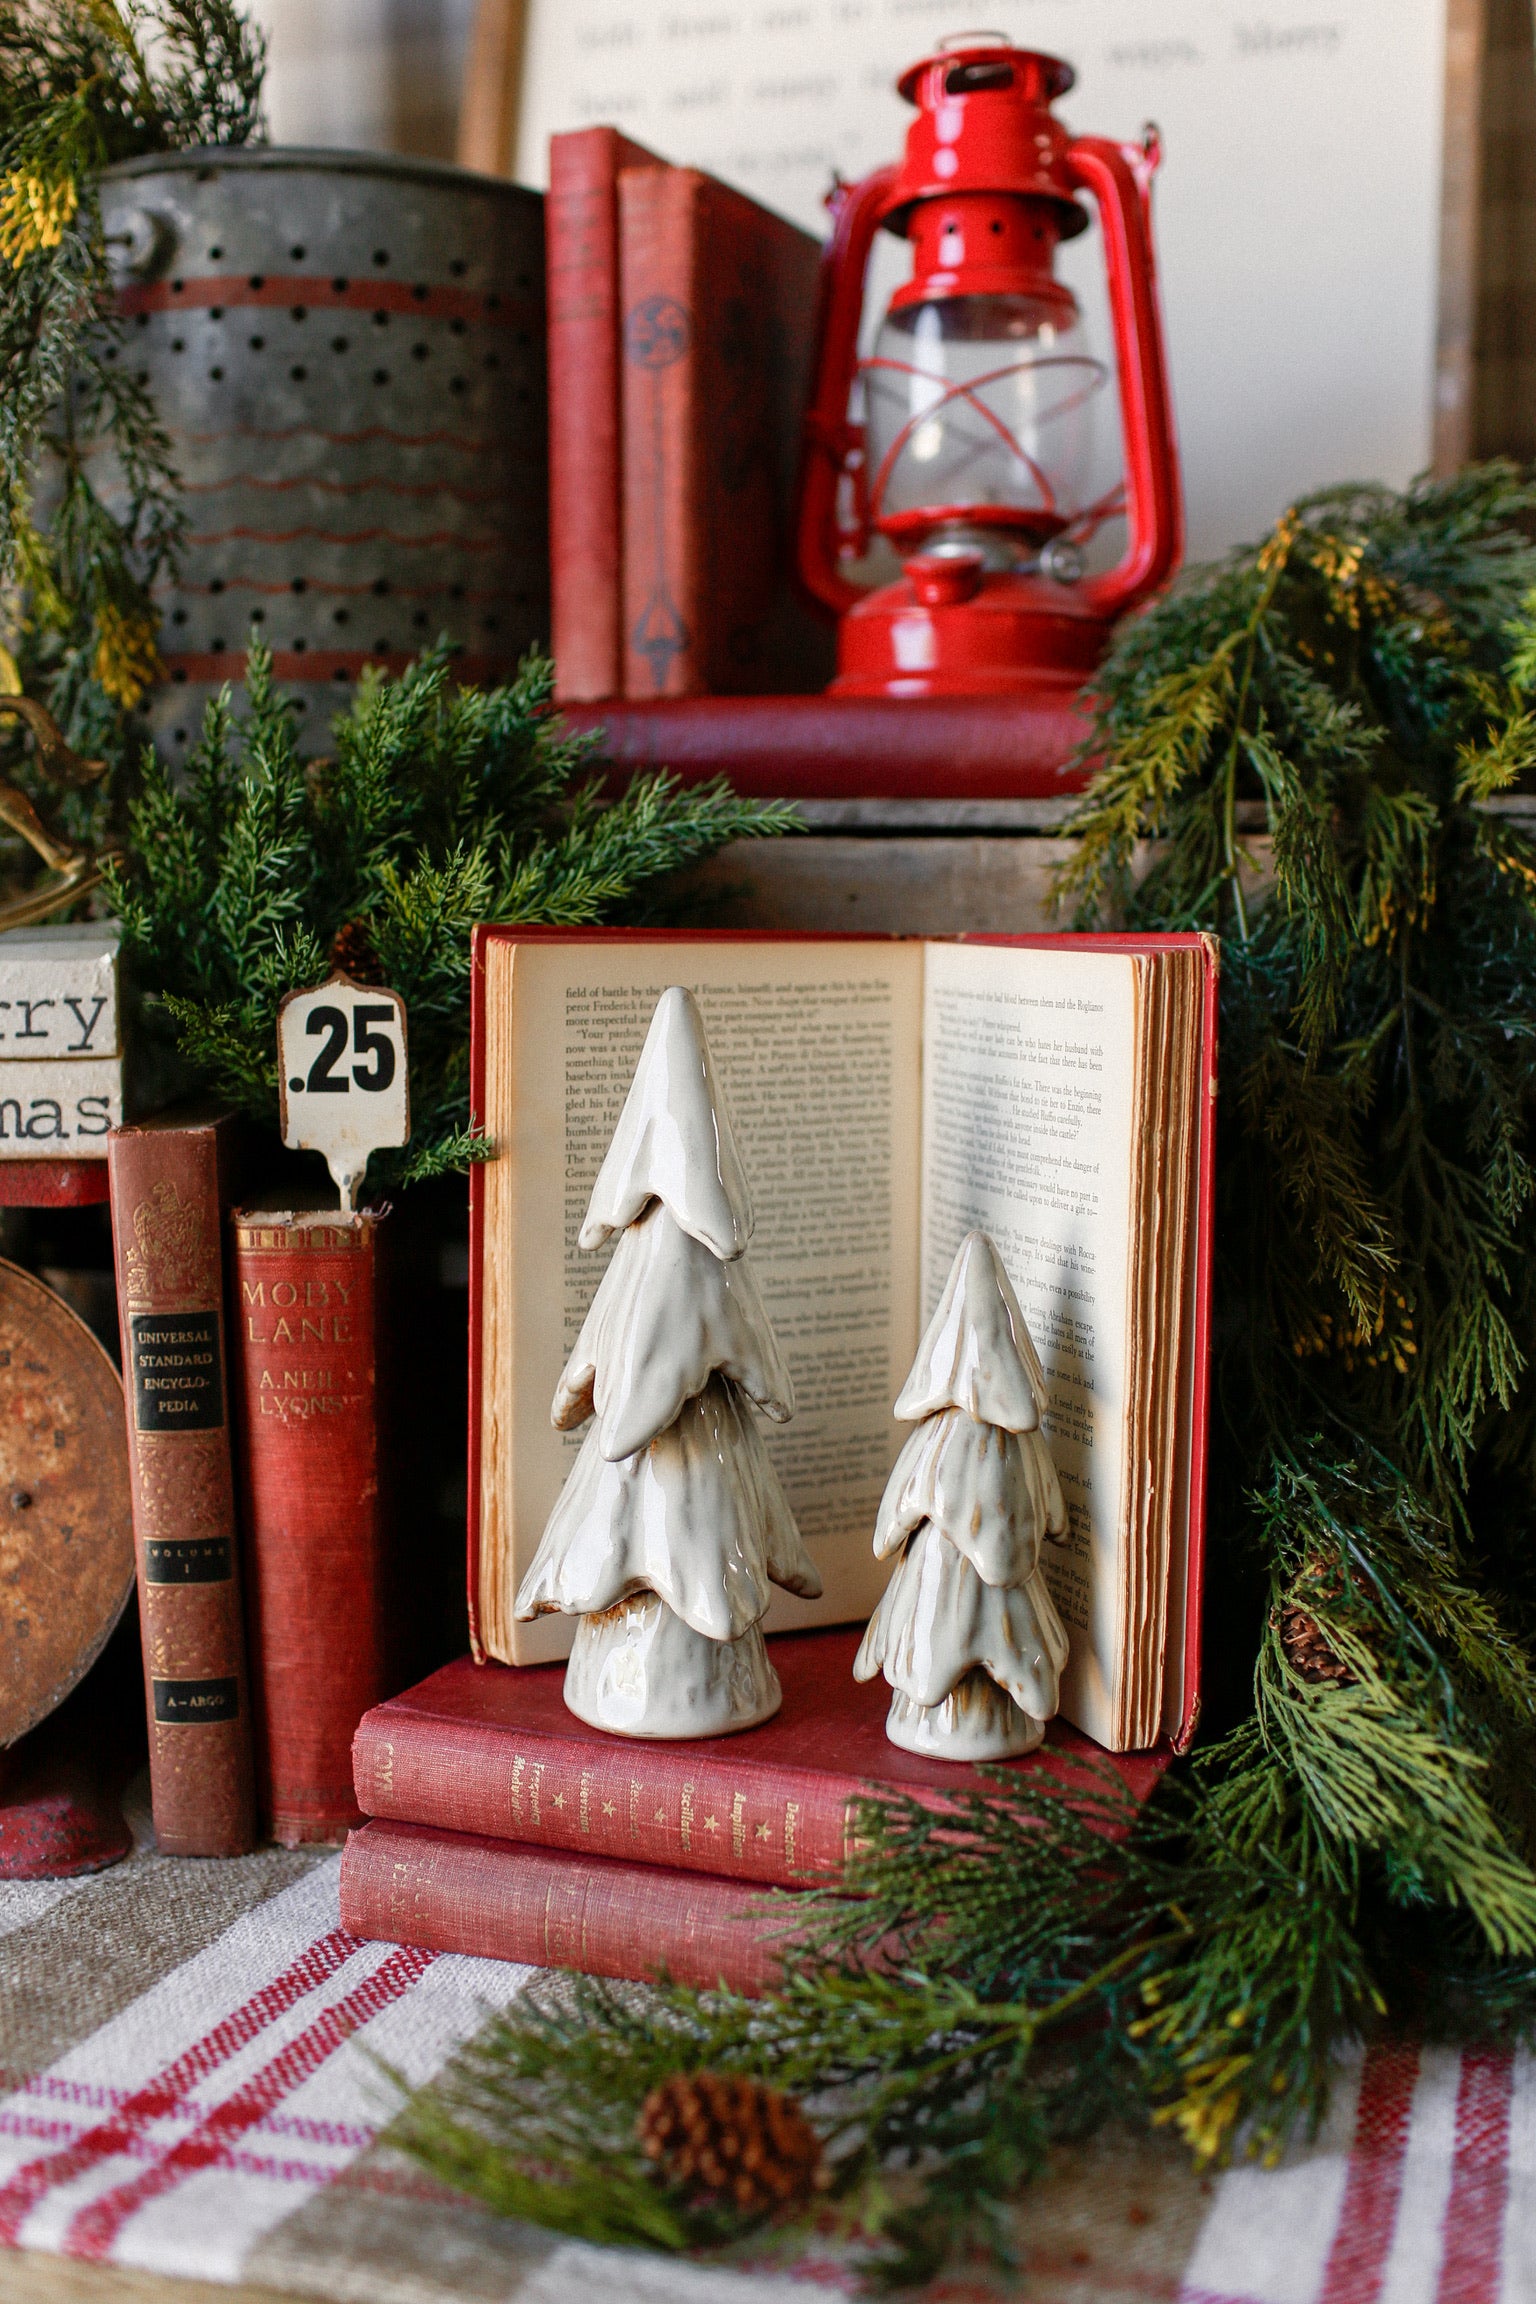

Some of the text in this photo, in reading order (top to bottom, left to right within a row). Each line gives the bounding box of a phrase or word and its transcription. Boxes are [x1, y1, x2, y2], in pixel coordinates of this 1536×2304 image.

[566, 987, 586, 998] field
[589, 987, 600, 998] of
[602, 986, 628, 997] battle
[631, 986, 642, 998] by
[566, 1000, 652, 1014] peror Frederick for
[1055, 998, 1066, 1009] and
[1067, 998, 1076, 1010] the
[566, 1014, 638, 1027] more respectful
[289, 1005, 396, 1093] .25
[566, 1046, 586, 1054] now
[590, 1045, 608, 1053] was
[1053, 1039, 1063, 1052] her
[1064, 1041, 1088, 1055] husband
[566, 1055, 635, 1068] something like
[1028, 1051, 1037, 1063] the
[1038, 1052, 1048, 1064] fact
[1062, 1055, 1077, 1068] there
[1078, 1057, 1088, 1069] has
[1089, 1058, 1103, 1072] been
[566, 1071, 607, 1081] baseborn
[566, 1083, 609, 1095] the walls.
[1034, 1080, 1050, 1093] There
[1051, 1085, 1062, 1095] was
[1063, 1084, 1073, 1097] the
[1074, 1085, 1102, 1103] beginning
[565, 1098, 620, 1111] gled his fat
[1086, 1102, 1102, 1116] there
[565, 1112, 618, 1123] longer. He
[565, 1127, 601, 1137] humble
[1033, 1124, 1058, 1137] inside the
[565, 1140, 587, 1150] than
[565, 1154, 586, 1165] The
[1029, 1152, 1062, 1167] comprehend
[1062, 1156, 1072, 1169] the
[1072, 1158, 1092, 1175] danger
[1092, 1161, 1100, 1174] of
[1039, 1181, 1056, 1195] would
[1056, 1183, 1070, 1197] have
[1079, 1189, 1091, 1203] part
[565, 1198, 586, 1206] men
[1050, 1196, 1069, 1211] deliver
[1075, 1202, 1086, 1216] gift
[564, 1249, 592, 1260] of his
[1063, 1243, 1077, 1257] with
[1057, 1255, 1069, 1269] that
[1070, 1258, 1079, 1272] his
[242, 1279, 361, 1309] MOBY
[1048, 1284, 1062, 1296] even
[1067, 1288, 1096, 1307] possibility
[1049, 1309, 1073, 1327] Abraham
[137, 1330, 212, 1345] UNIVERSAL
[248, 1316, 354, 1345] LANE
[1066, 1327, 1074, 1341] all
[1074, 1333, 1087, 1345] men
[1088, 1336, 1096, 1348] of
[1061, 1343, 1078, 1358] easily
[1084, 1348, 1095, 1362] the
[139, 1353, 213, 1368] STANDARD
[143, 1376, 210, 1391] ENCYCLO-
[1056, 1369, 1071, 1383] some
[1072, 1371, 1082, 1386] ink
[1083, 1377, 1095, 1391] and
[157, 1399, 199, 1414] PEDIA
[1059, 1399, 1073, 1411] need
[1074, 1403, 1086, 1418] only
[1072, 1418, 1094, 1433] another
[1072, 1429, 1079, 1441] do
[1081, 1433, 1093, 1447] find
[680, 1782, 696, 1852] Oscillators
[730, 1792, 748, 1859] Amplifiers
[784, 1802, 800, 1866] Detectors
